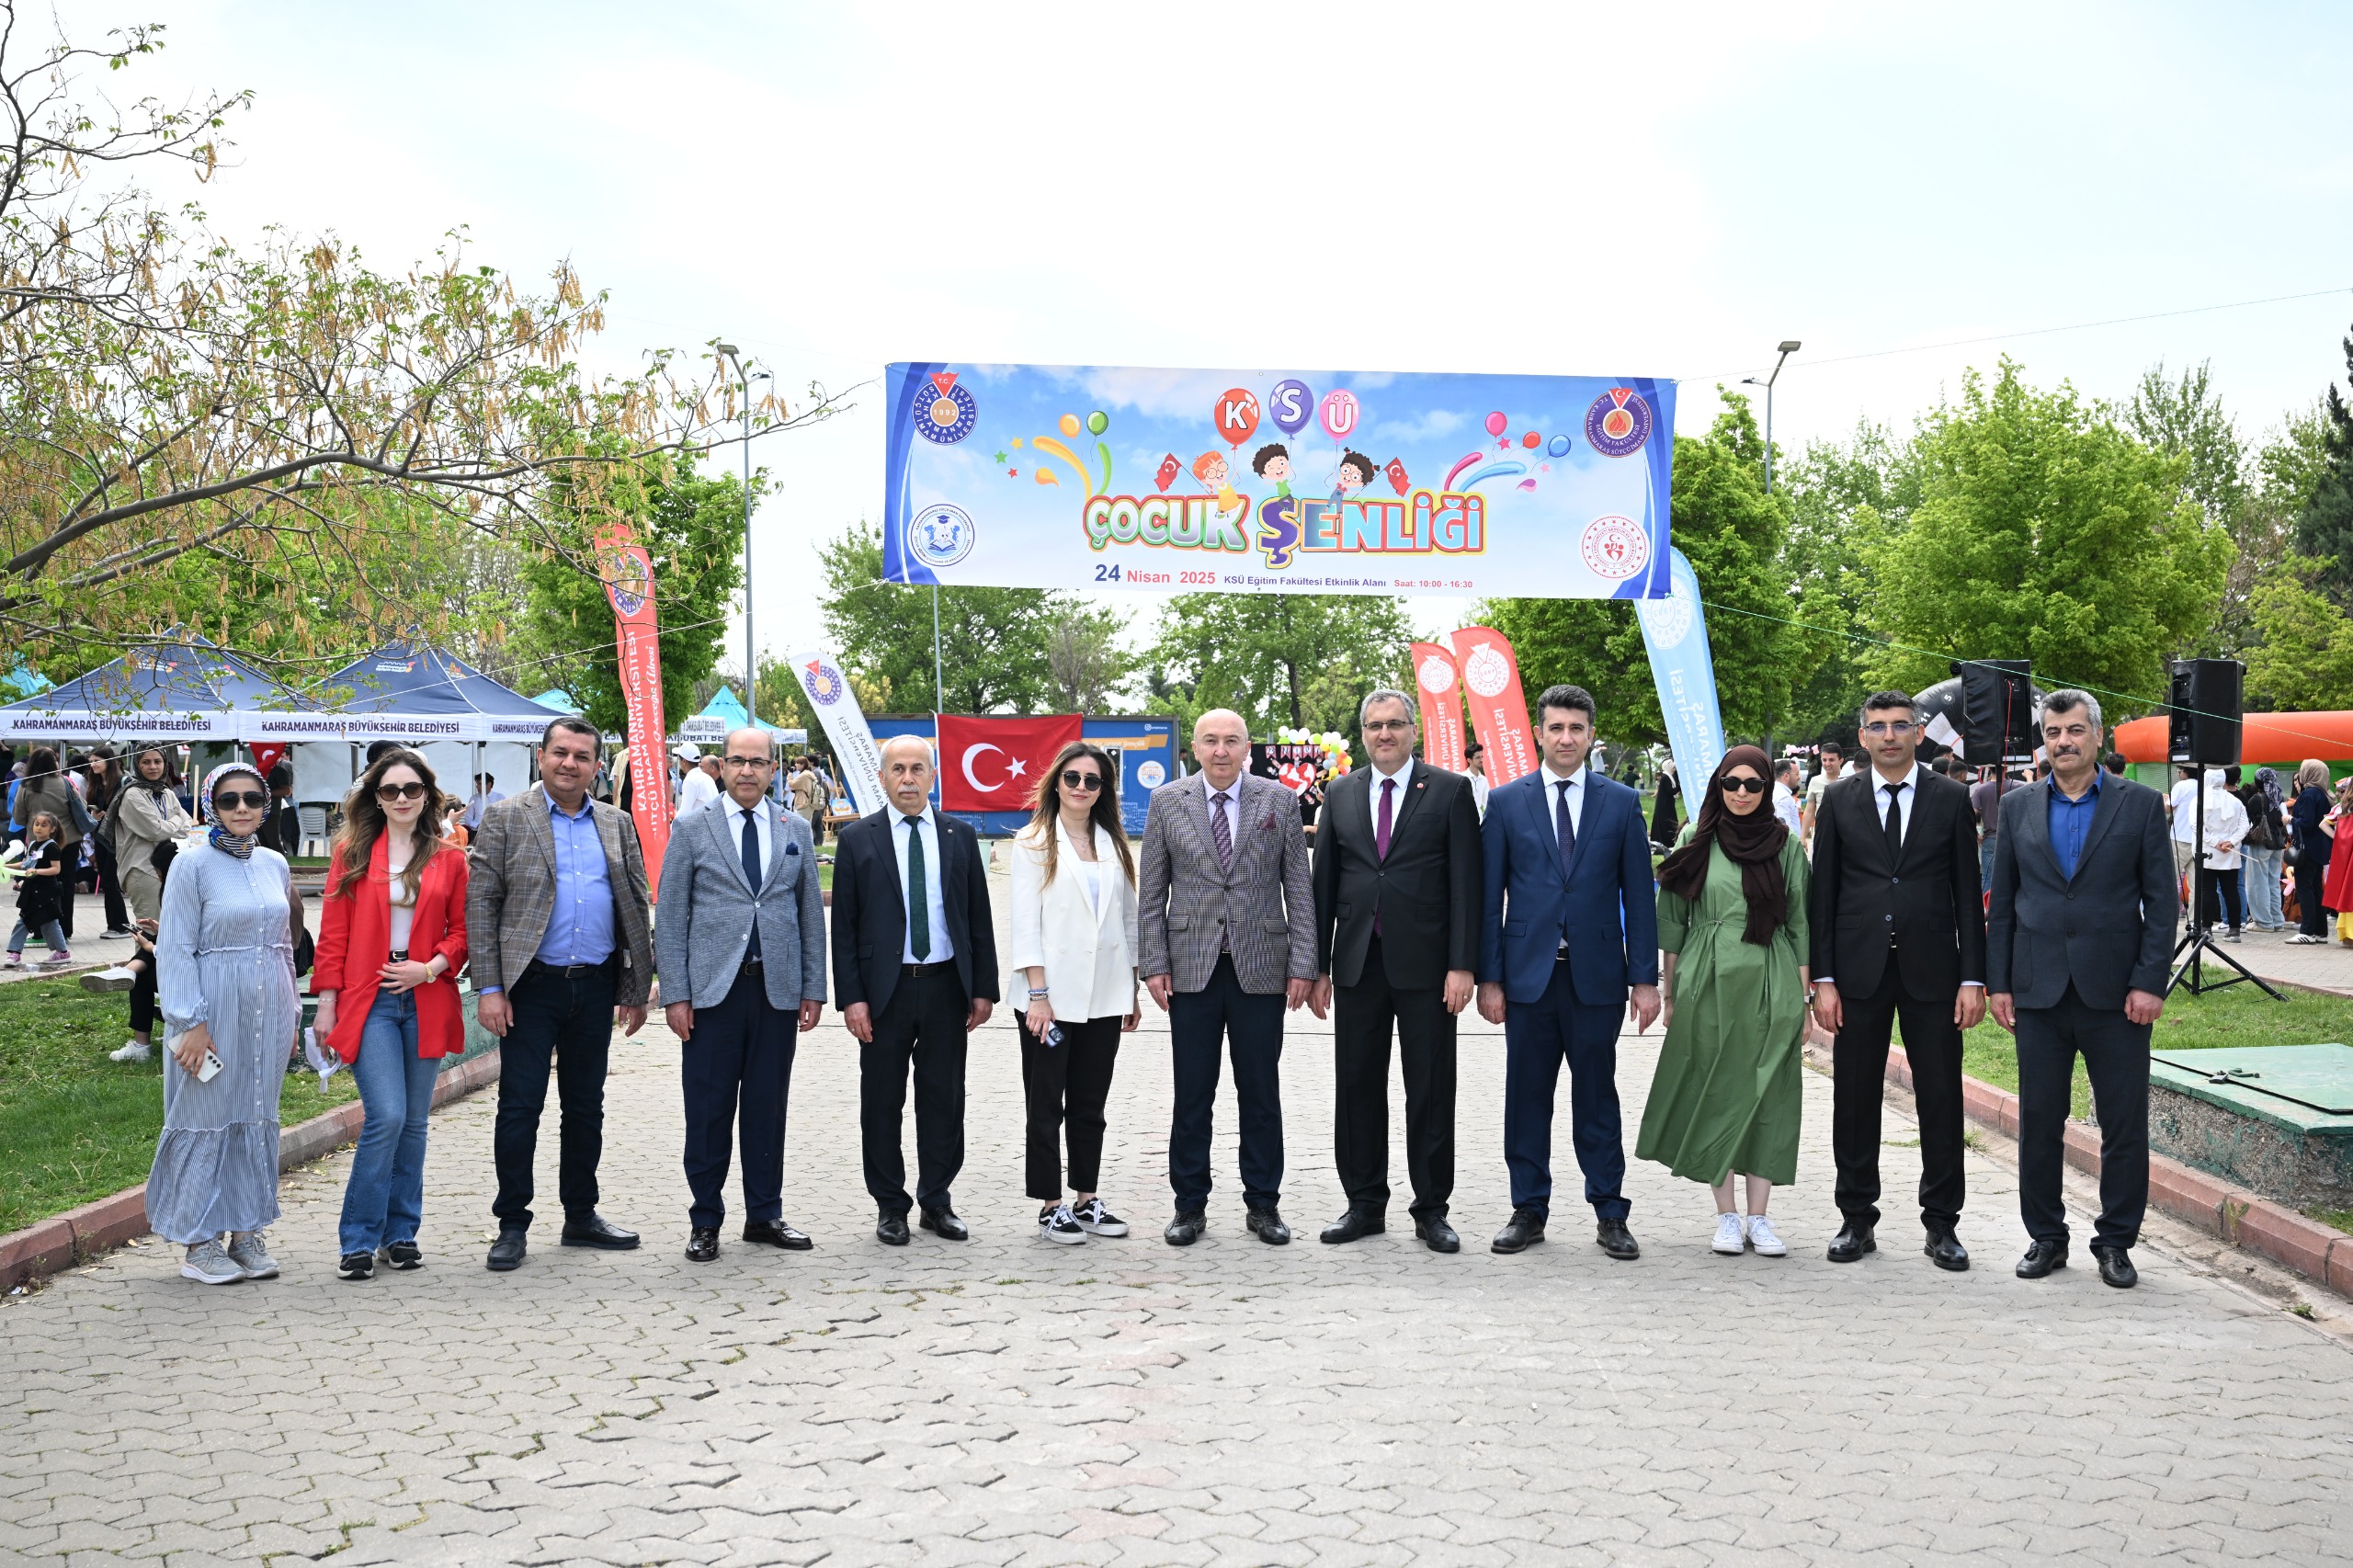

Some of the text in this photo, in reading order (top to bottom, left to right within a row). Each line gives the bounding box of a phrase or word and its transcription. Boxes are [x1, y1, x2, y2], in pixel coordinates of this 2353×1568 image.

[1086, 493, 1484, 567] ÇOCUK ŞENLİĞİ
[1095, 564, 1121, 582] 24
[1127, 570, 1170, 584] Nisan
[1179, 571, 1215, 584] 2025
[1224, 574, 1245, 584] KSÜ
[1247, 575, 1277, 586] Eğitim
[1279, 576, 1322, 586] Fakültesi
[1325, 578, 1359, 586] Etkinlik
[1362, 578, 1386, 587] Alanı
[1394, 579, 1415, 588] Saat:
[1419, 580, 1441, 588] 10:00
[1450, 580, 1472, 588] 16:30
[1943, 694, 1951, 702] 5
[1921, 711, 1931, 723] 11
[13, 717, 211, 732] KAHRAMANMARAŞ BÜYÜKŞEHİR BELEDİYESİ
[261, 720, 460, 733] KAHRAMANMARAŞ BÜYÜKŞEHİR BELEDİYESİ
[493, 723, 526, 734] KAHRAMANMARAŞ
[642, 744, 656, 786] İMAM
